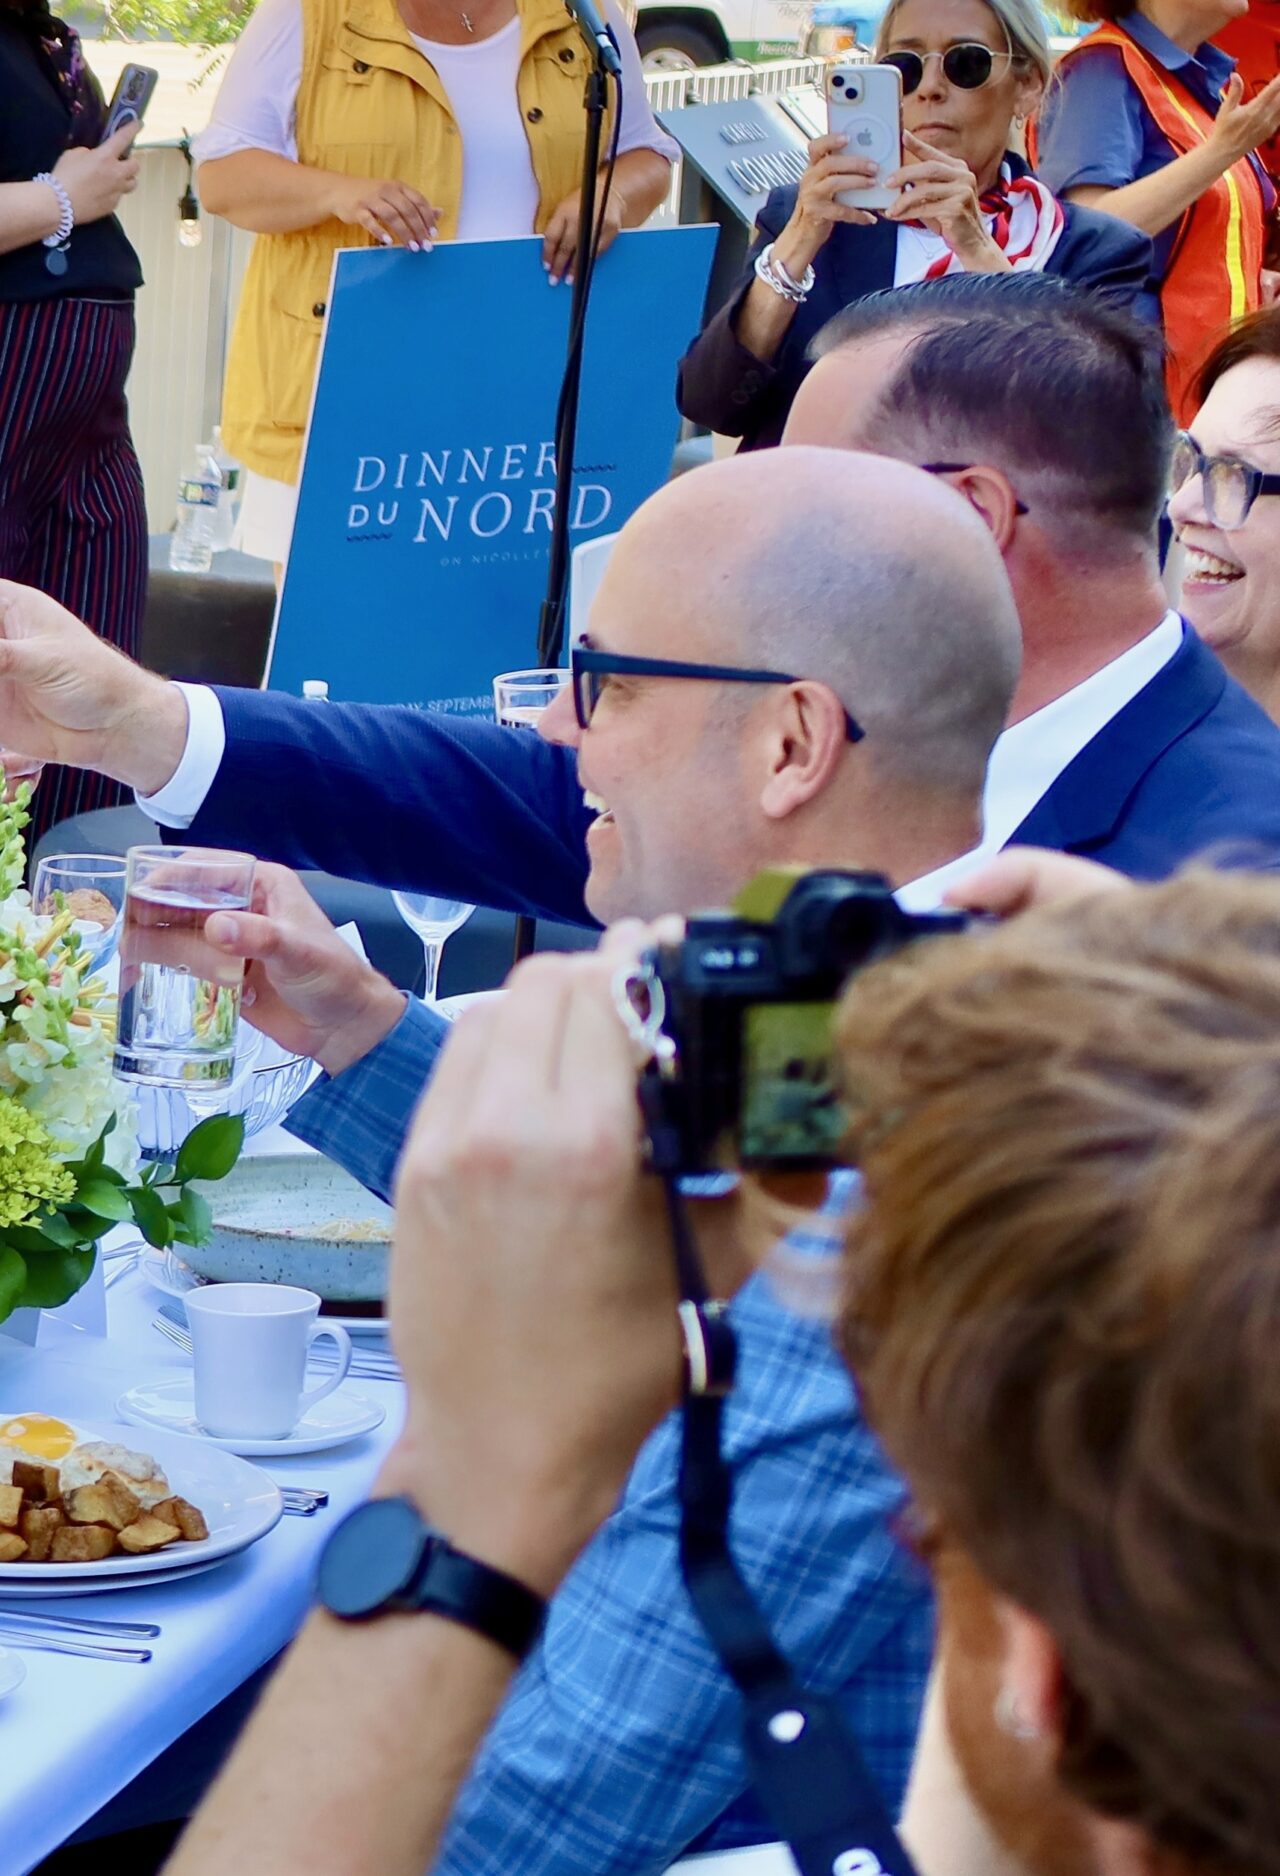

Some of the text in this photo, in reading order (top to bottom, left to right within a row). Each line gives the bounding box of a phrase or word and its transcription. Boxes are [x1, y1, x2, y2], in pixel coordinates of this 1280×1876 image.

[729, 149, 810, 192] COMMON
[353, 441, 558, 493] DINNER
[348, 485, 612, 544] DU NORD
[439, 556, 462, 567] ON
[427, 695, 494, 713] SEPTEMB
